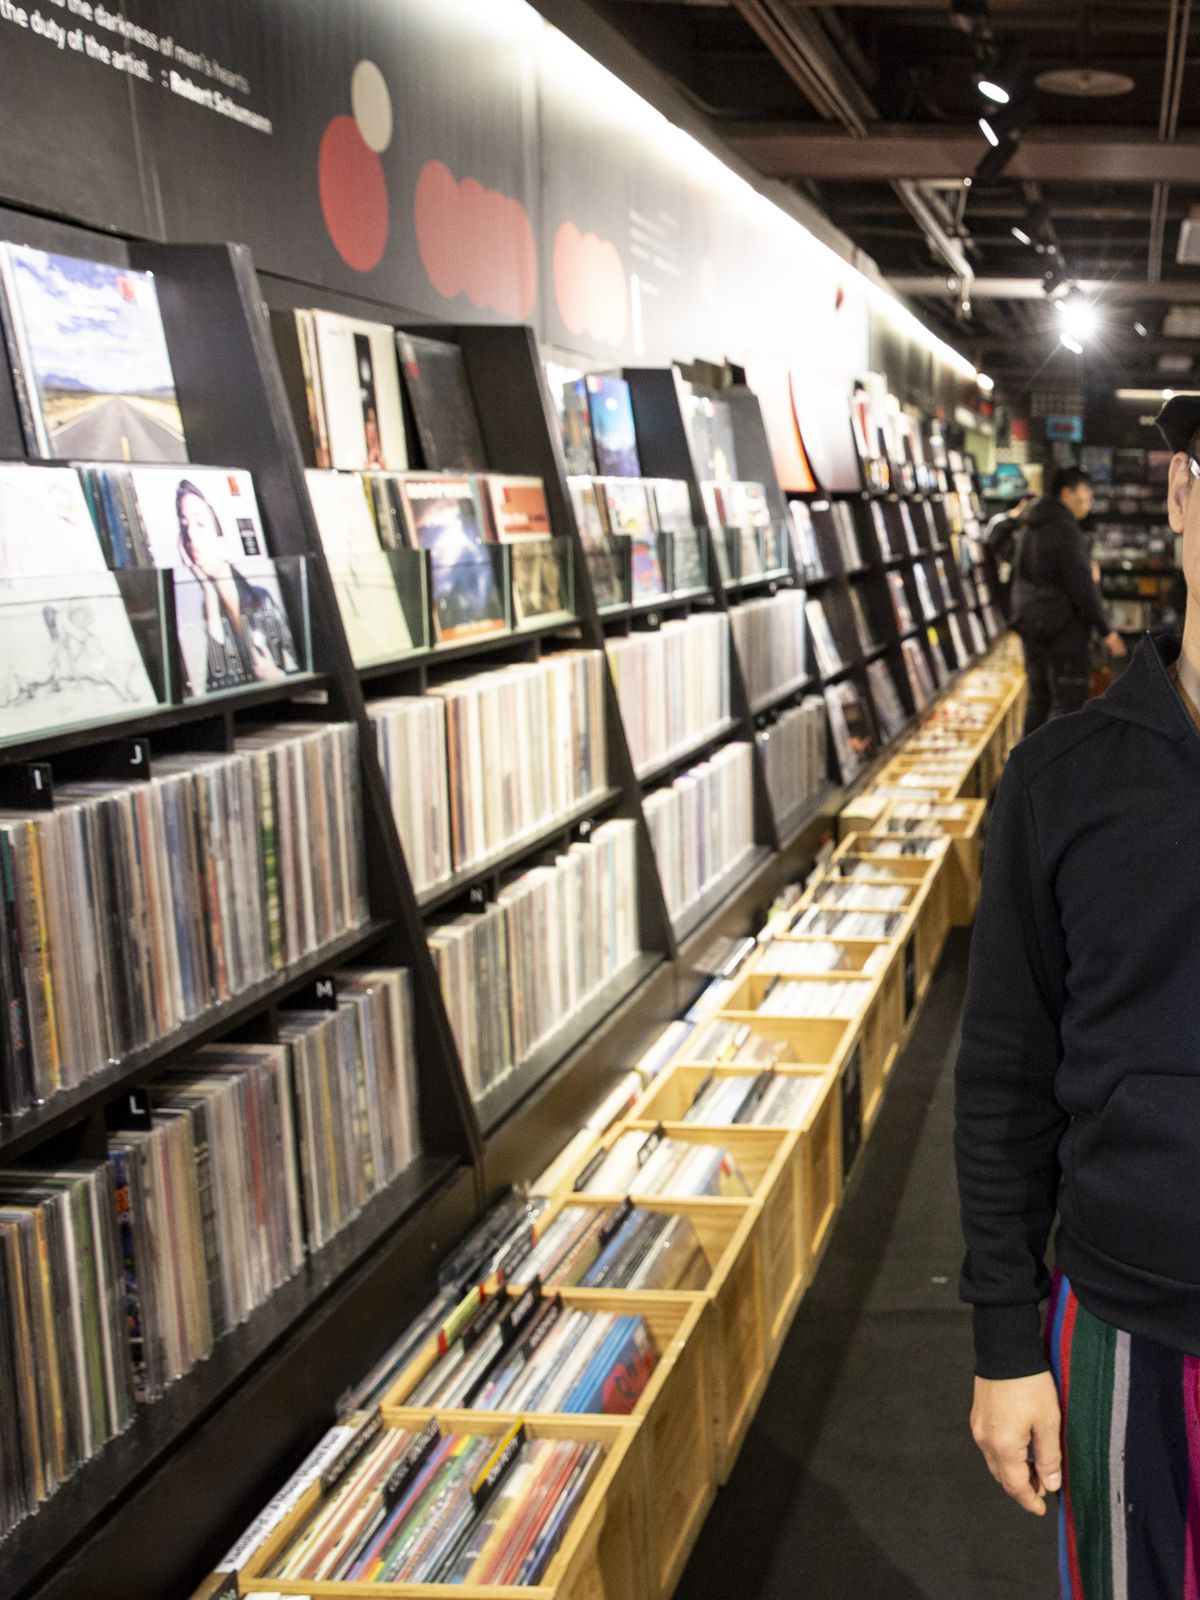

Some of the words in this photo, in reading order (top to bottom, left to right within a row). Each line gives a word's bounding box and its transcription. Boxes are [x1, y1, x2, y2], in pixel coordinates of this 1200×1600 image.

[30, 9, 66, 50] duty
[67, 28, 84, 52] of
[84, 34, 111, 65] the
[130, 744, 142, 765] J
[315, 979, 334, 998] M
